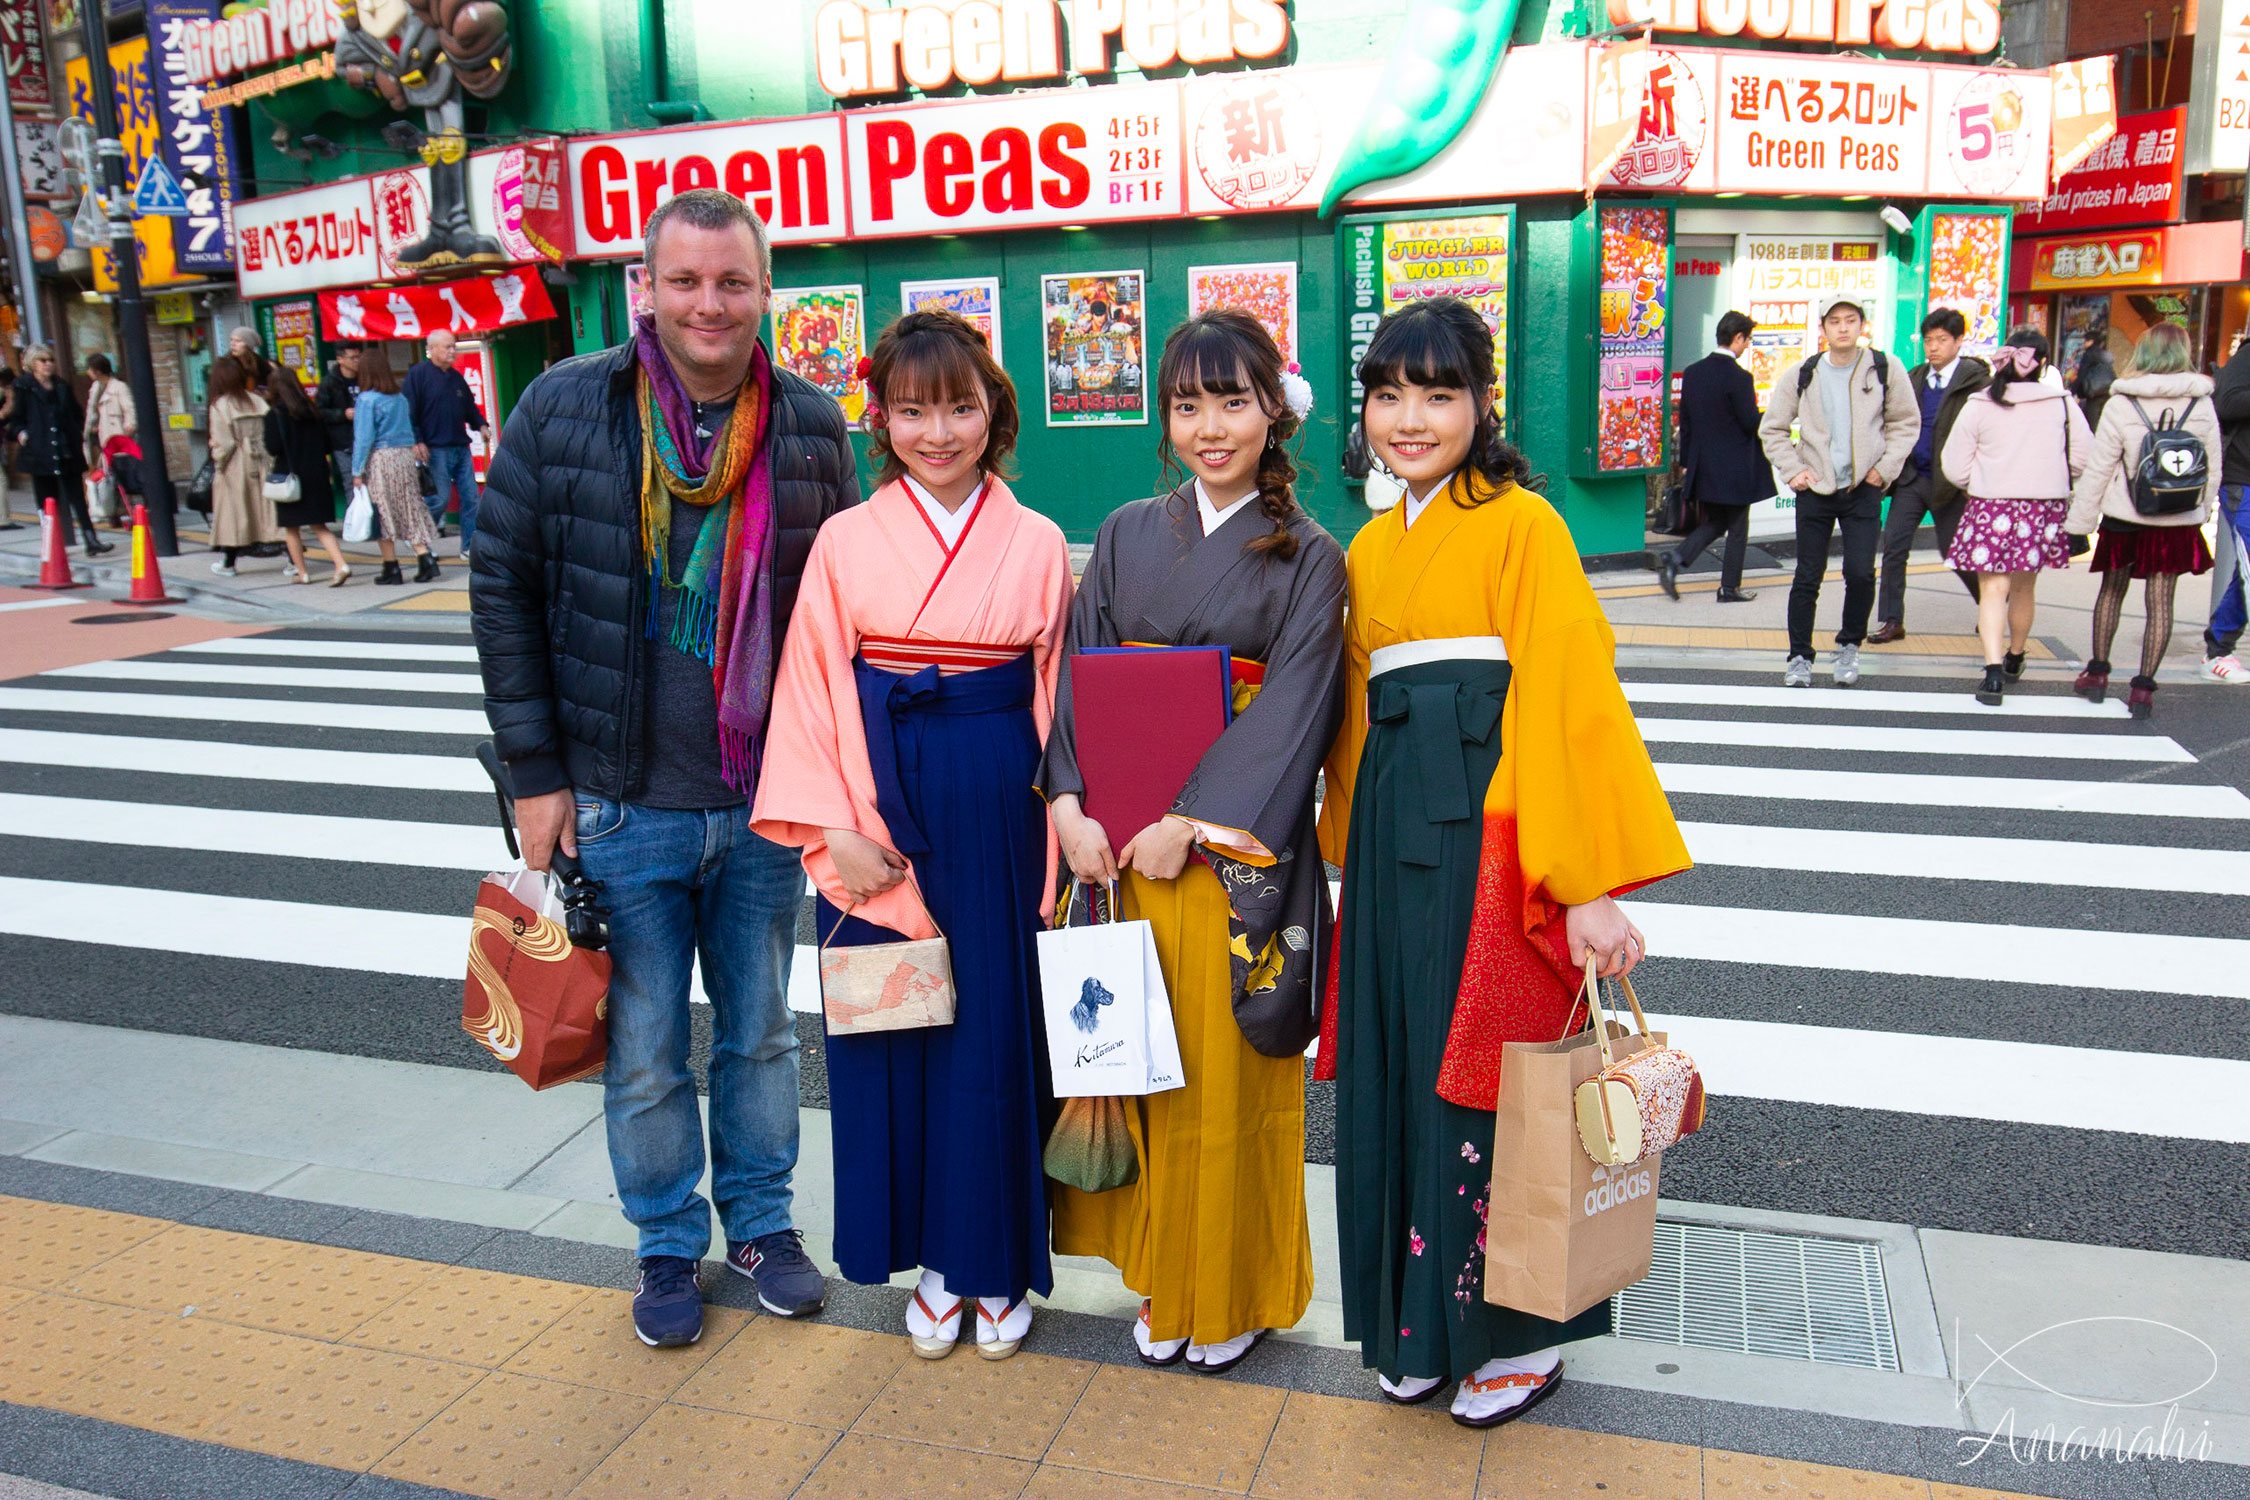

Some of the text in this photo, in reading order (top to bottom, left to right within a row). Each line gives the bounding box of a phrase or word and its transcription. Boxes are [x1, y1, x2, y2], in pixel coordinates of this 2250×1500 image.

[182, 0, 343, 84] Green Peas
[815, 0, 1062, 97] Green
[1731, 76, 1918, 126] 選べるスロット
[2219, 97, 2250, 129] B2
[1221, 87, 1287, 164] 新
[866, 119, 1091, 223] Peas
[1748, 131, 1899, 171] Green Peas
[385, 176, 416, 243] 新
[2045, 187, 2072, 213] and
[2070, 184, 2112, 215] prizes
[2113, 182, 2127, 206] in
[2128, 180, 2173, 208] Japan
[239, 207, 373, 272] 選べるスロット
[1389, 236, 1507, 261] JUGGLER
[1750, 242, 1830, 261] 1988年創業
[2053, 242, 2143, 279] 麻雀入口
[1355, 225, 1375, 308] Pachislo
[1404, 258, 1489, 280] WORLD
[1691, 257, 1722, 277] Peas
[1074, 1039, 1126, 1068] Kitamura
[1583, 1168, 1652, 1217] adidas
